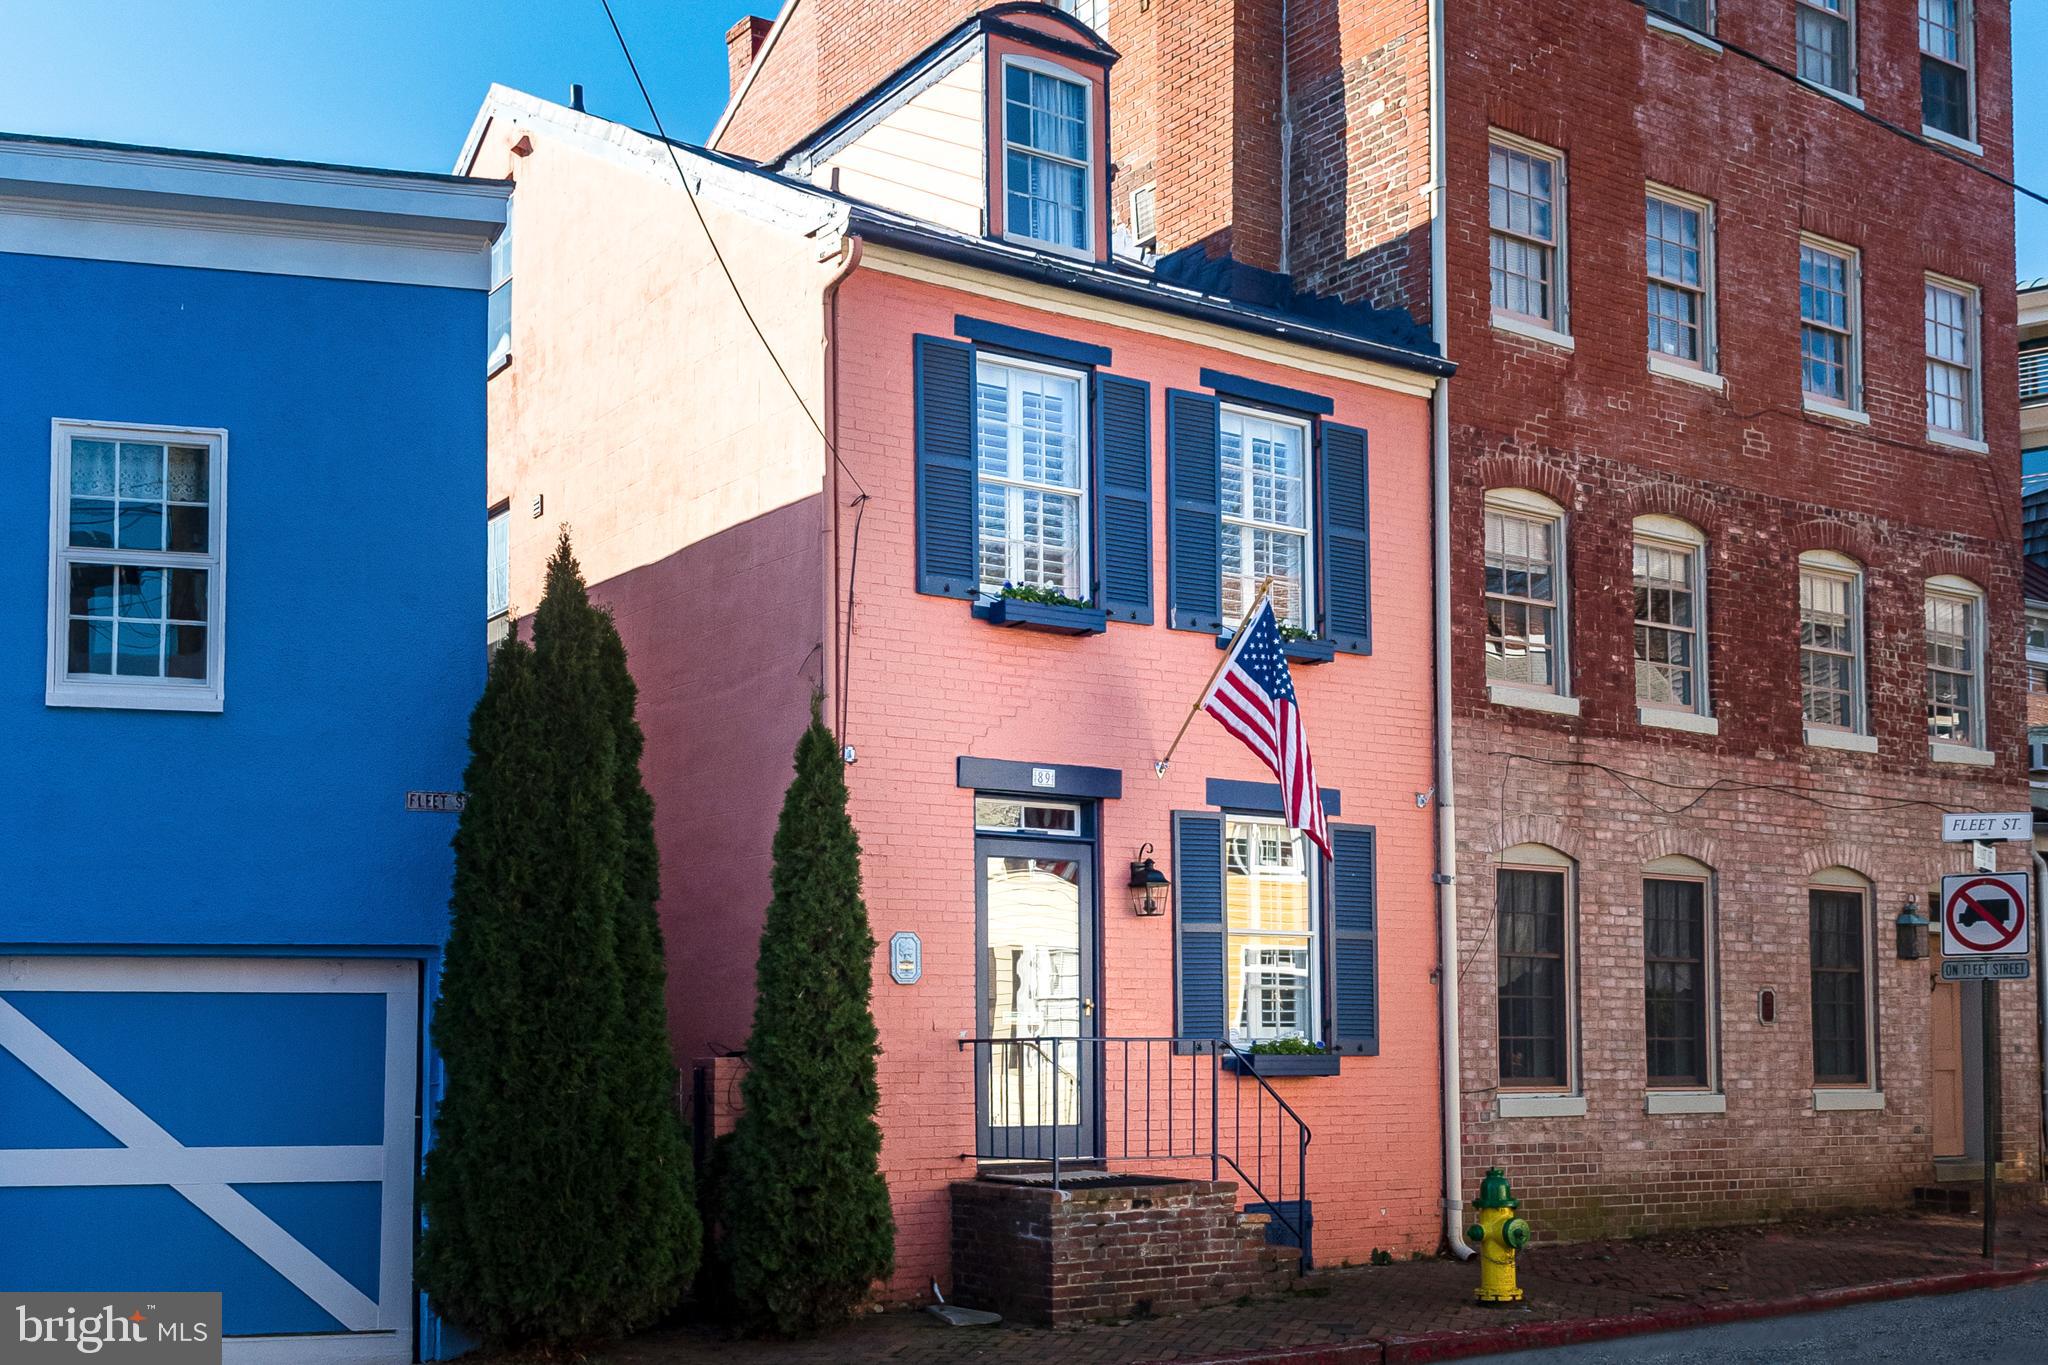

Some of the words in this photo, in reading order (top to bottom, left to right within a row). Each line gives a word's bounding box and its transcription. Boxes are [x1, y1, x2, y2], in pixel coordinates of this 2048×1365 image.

[1037, 771, 1051, 784] 89
[409, 793, 448, 809] FLEET
[1952, 818, 1997, 832] FLEET
[2001, 817, 2022, 831] ST.
[1945, 964, 1958, 976] ON
[1992, 962, 2025, 975] STREET
